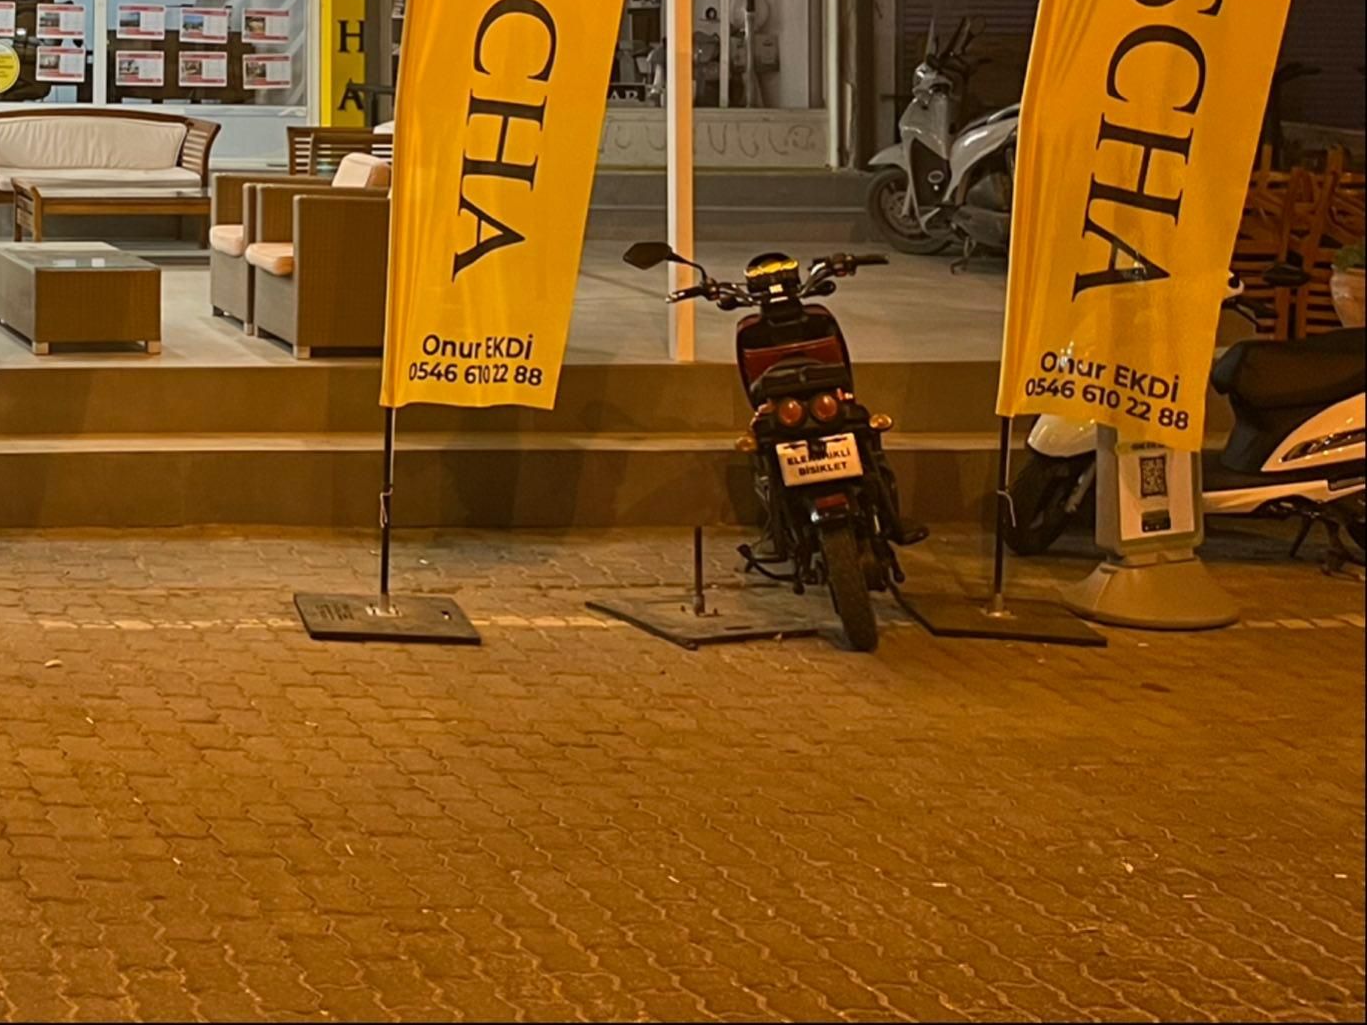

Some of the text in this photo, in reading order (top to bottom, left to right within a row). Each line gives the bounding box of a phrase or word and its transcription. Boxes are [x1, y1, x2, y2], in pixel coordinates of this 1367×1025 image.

[422, 333, 534, 360] Onur EKDİ
[409, 362, 543, 386] 0546 610 22 88
[1040, 351, 1180, 403] Onur EKDİ
[1025, 377, 1190, 430] 0546 610 22 88
[798, 461, 848, 476] BİSİKLET
